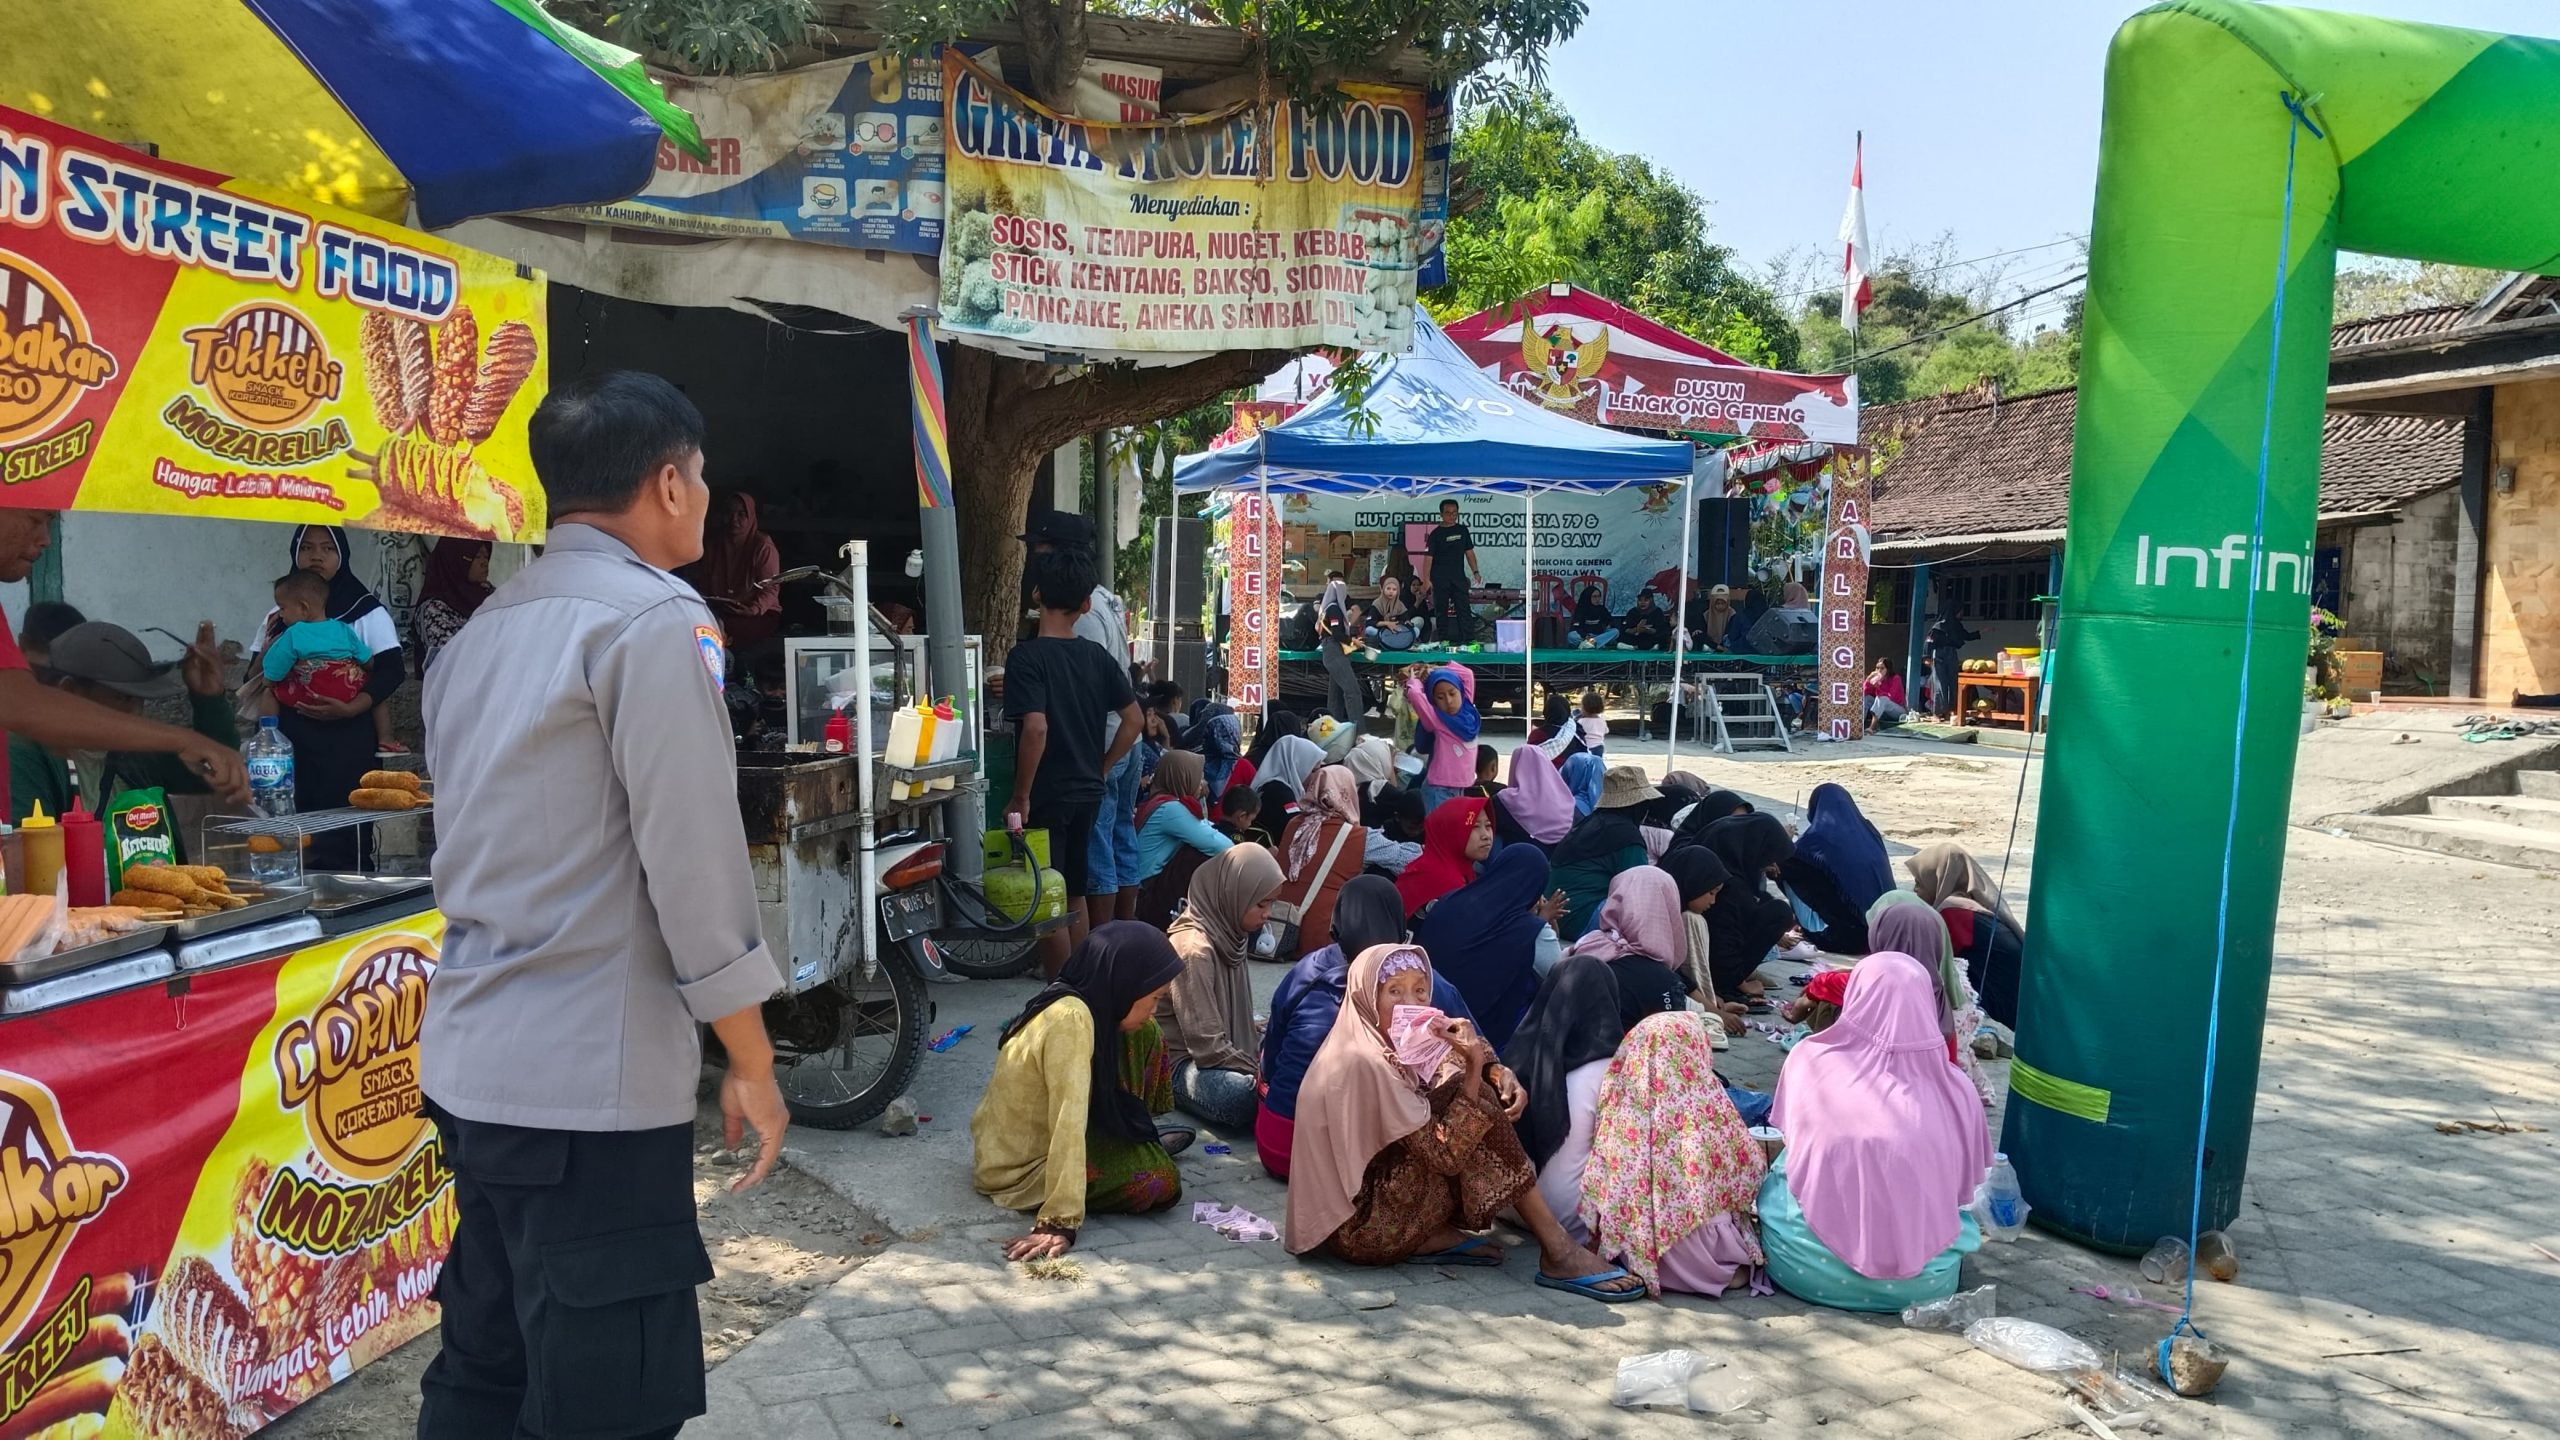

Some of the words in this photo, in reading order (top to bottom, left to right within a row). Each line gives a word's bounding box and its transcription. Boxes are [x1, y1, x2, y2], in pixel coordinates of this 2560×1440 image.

[1102, 73, 1161, 101] MASUK
[1286, 98, 1415, 188] FOOD
[605, 206, 665, 226] KAHURIPAN
[668, 217, 717, 231] NIRWANA
[720, 223, 773, 237] SIDOARJO
[1129, 192, 1241, 222] Menyediakan
[65, 157, 303, 282] STREET
[322, 230, 453, 316] FOOD
[991, 215, 1075, 256] SOSIS,
[1084, 226, 1202, 262] TEMPURA,
[1207, 231, 1287, 262] NUGET,
[1293, 229, 1371, 265] KEBAB,
[991, 251, 1062, 288] STICK
[1070, 261, 1187, 299] KENTANG,
[1193, 266, 1280, 297] BAKSO,
[1004, 290, 1130, 334] PANCAKE,
[1135, 302, 1213, 331] ANEKA
[1221, 301, 1319, 331] SAMBAL
[183, 327, 342, 401] Tokkebi
[228, 389, 270, 406] KOREAN
[269, 396, 297, 409] FOOD
[246, 381, 284, 398] SNACK
[1385, 387, 1515, 417] vivo
[1674, 378, 1745, 401] DUSUN
[1607, 392, 1722, 419] LENGKONG
[1727, 405, 1806, 424] GENENG
[164, 397, 349, 464] MOZARELLA
[7, 424, 91, 480] STREET
[156, 461, 219, 497] Hangat
[1355, 512, 1390, 528] HUT
[1562, 513, 1582, 529] 79
[1585, 513, 1599, 529] &
[1561, 532, 1601, 548] SAW
[1531, 569, 1602, 577] BERSHOLAWAT
[1575, 558, 1613, 567] GENENG
[2135, 534, 2314, 596] Infini
[250, 764, 279, 778] AQUA
[121, 833, 170, 863] KETCHUP
[363, 1060, 413, 1096] SNACK
[337, 1095, 398, 1137] KOREAN
[401, 1089, 423, 1115] FO
[231, 1337, 318, 1401] Hangat
[325, 1287, 390, 1356] Lebih
